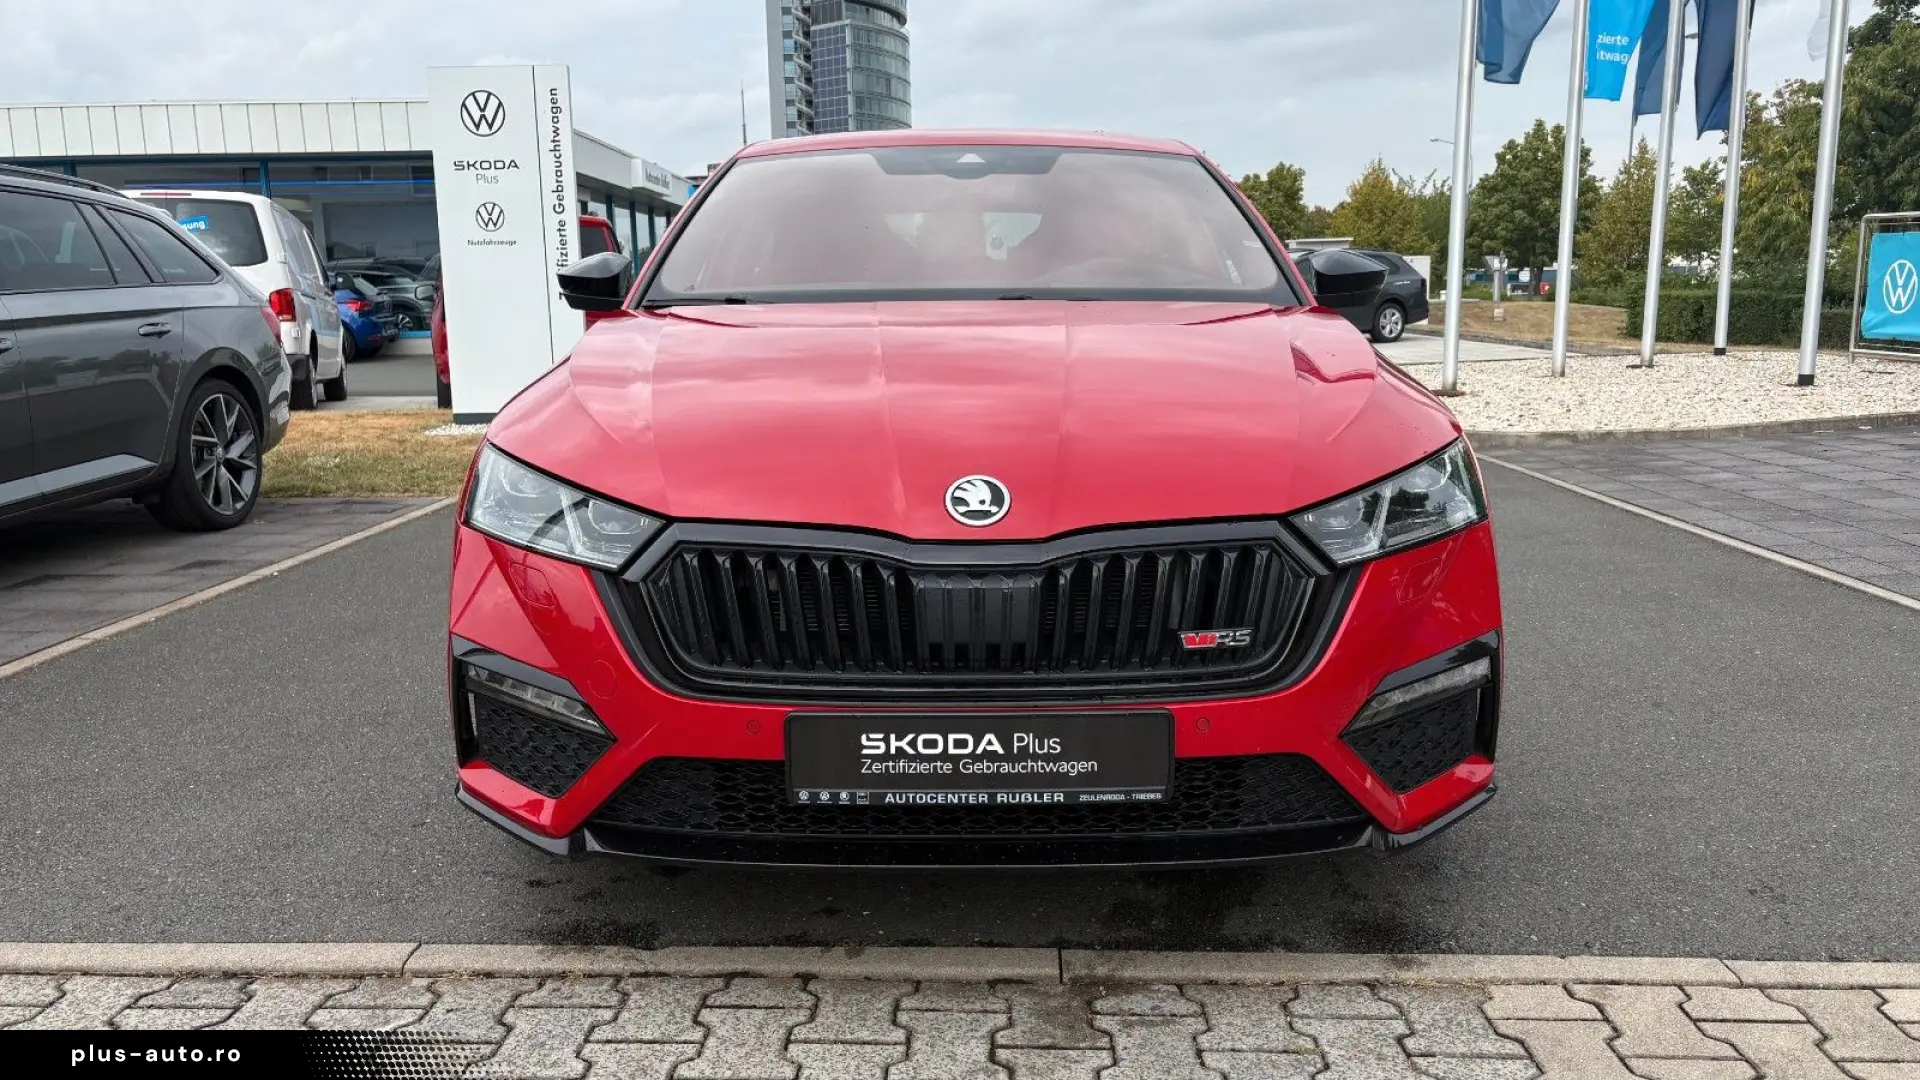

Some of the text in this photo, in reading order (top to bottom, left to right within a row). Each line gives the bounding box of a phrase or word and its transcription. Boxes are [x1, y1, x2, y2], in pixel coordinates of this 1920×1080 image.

[1596, 32, 1630, 46] zierte
[549, 88, 565, 214] Gebrauchtwagen
[475, 173, 499, 185] Plus
[1013, 732, 1062, 754] Plus
[860, 758, 1098, 776] Zertifizierte Gebrauchtwagen
[884, 792, 989, 804] AUTOCENTER
